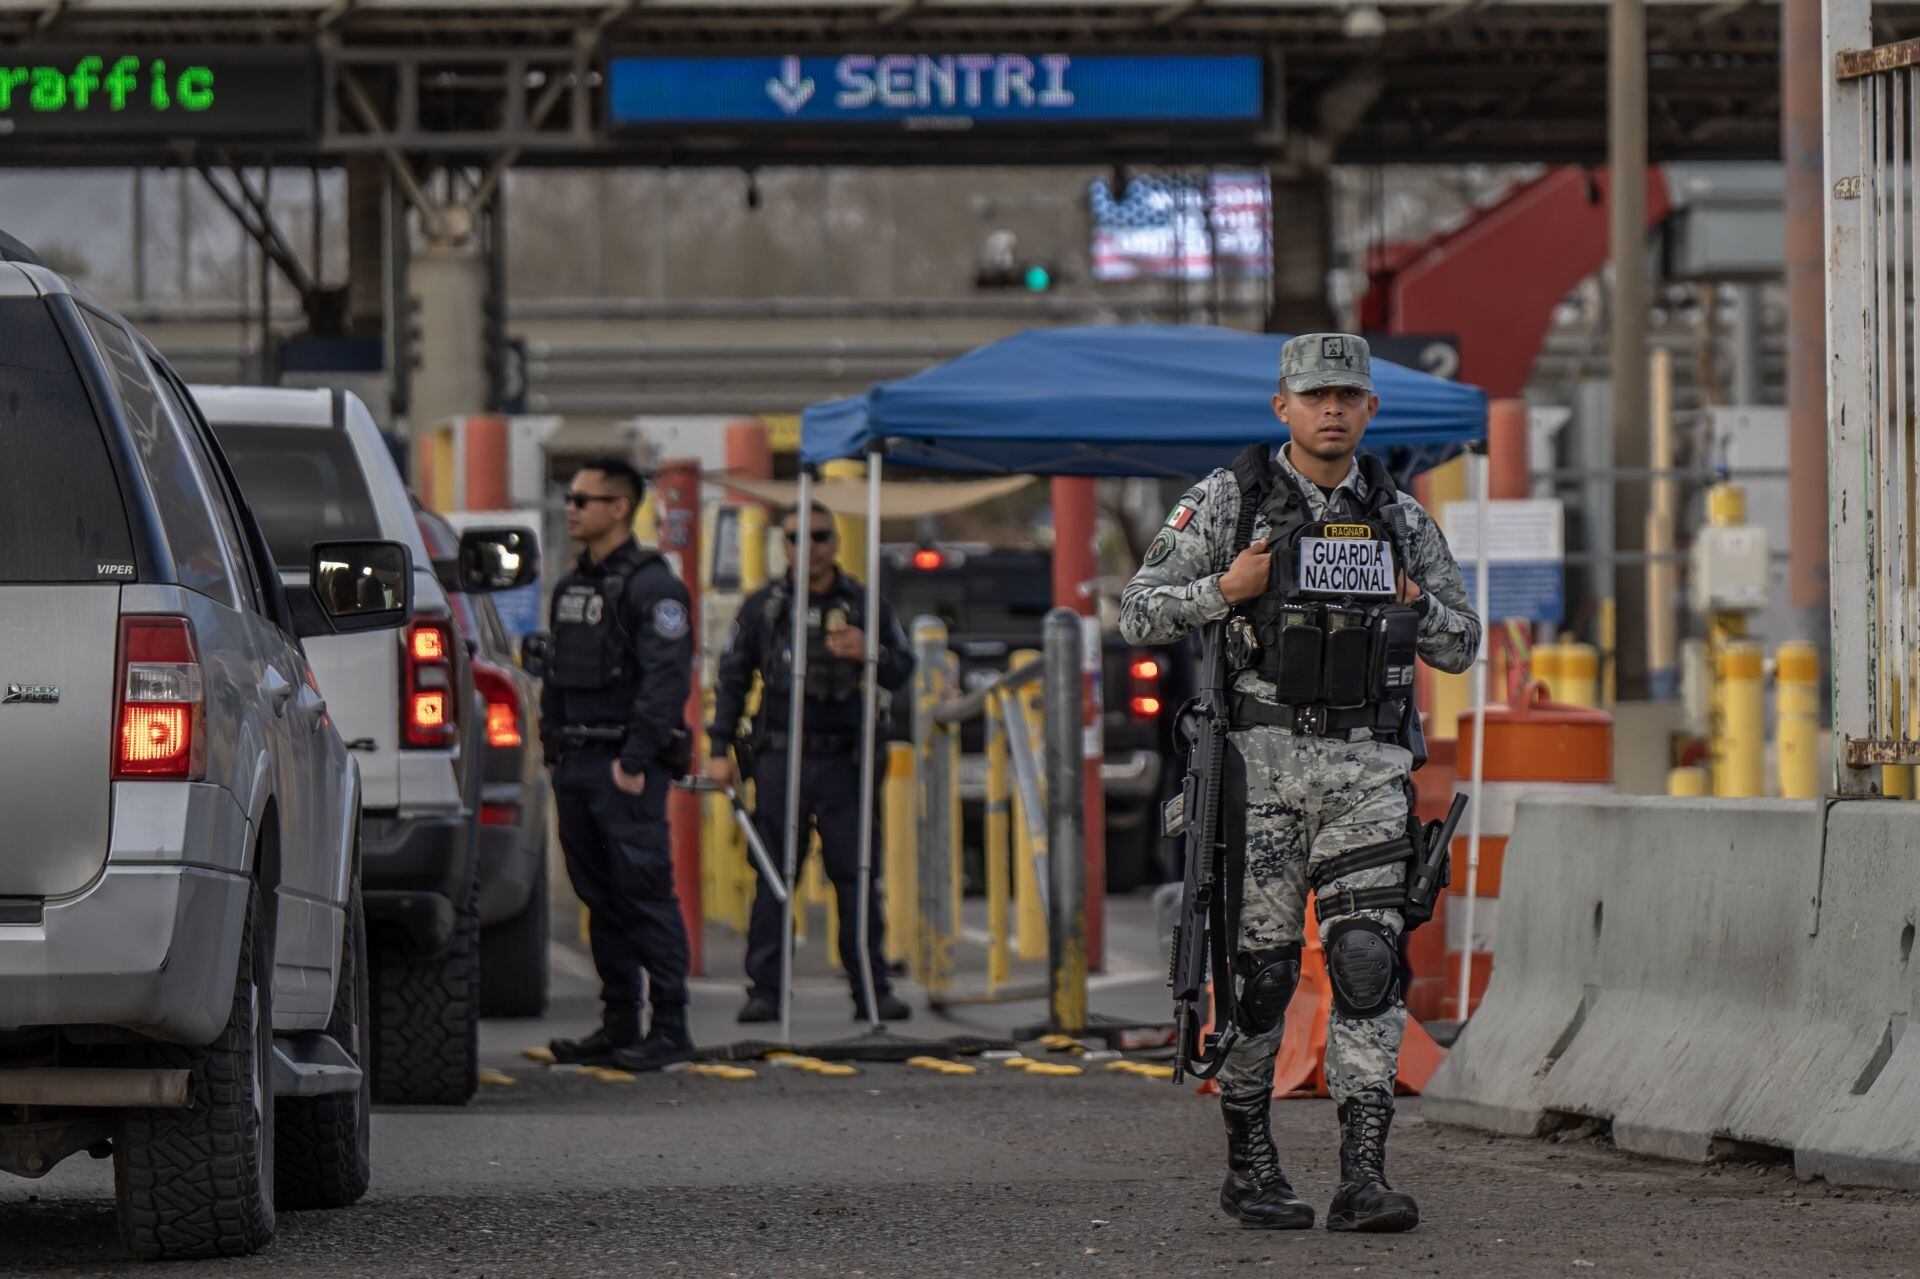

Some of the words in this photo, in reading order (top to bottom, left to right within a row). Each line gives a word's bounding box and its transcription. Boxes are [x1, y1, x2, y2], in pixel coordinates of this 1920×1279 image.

[834, 53, 1075, 109] SENTRI
[1332, 526, 1365, 536] RAGNAR
[1313, 541, 1384, 566] GUARDIA
[97, 564, 133, 575] VIPER
[1305, 565, 1391, 591] NACIONAL
[25, 686, 57, 694] FLEX
[25, 693, 54, 701] FUEL
